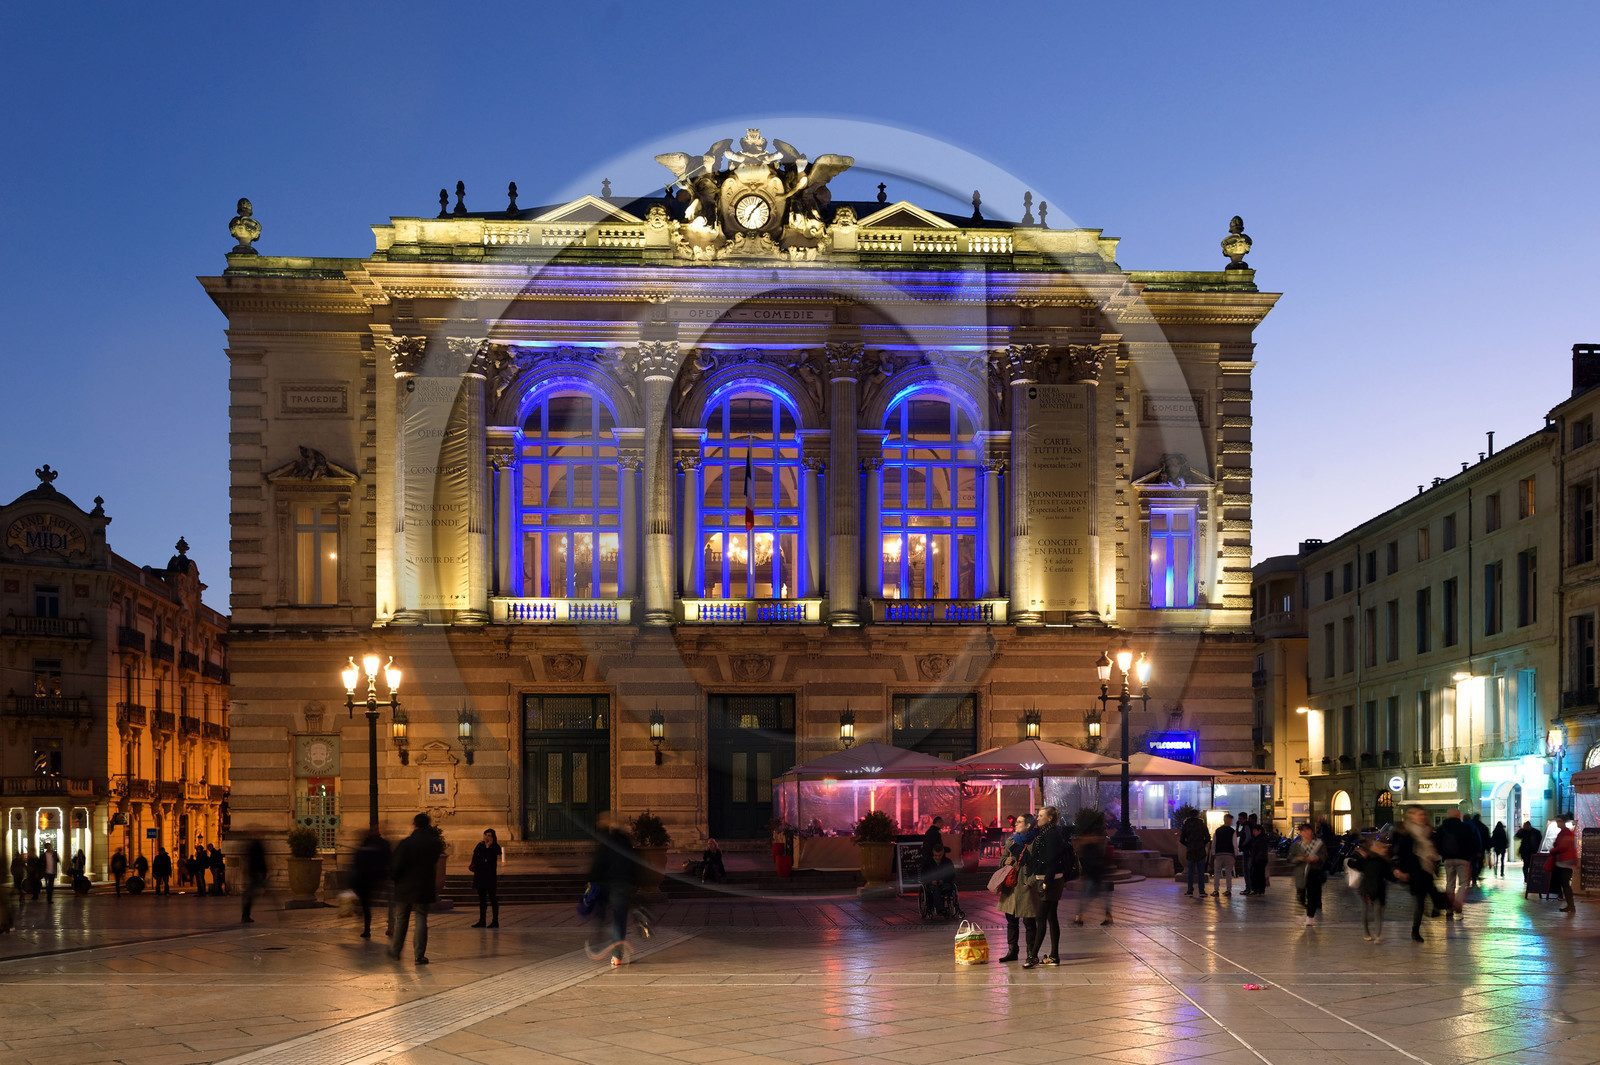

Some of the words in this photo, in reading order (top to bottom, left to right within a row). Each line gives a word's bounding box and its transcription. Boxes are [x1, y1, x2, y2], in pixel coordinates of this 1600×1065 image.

[689, 309, 732, 319] OPERA
[753, 310, 815, 319] COMEDIE
[290, 395, 338, 403] TRAGEDIE
[1152, 404, 1194, 412] COMEDIE
[1043, 438, 1072, 446] CARTE
[1063, 446, 1083, 454] PASS
[1037, 461, 1066, 470] spectacles
[410, 466, 462, 474] CONCERTS
[1028, 490, 1089, 498] ABONNEMENT
[411, 503, 436, 511] POUR
[437, 503, 463, 512] TOUT
[1035, 505, 1065, 514] spectacles
[413, 519, 424, 527] LE
[425, 519, 461, 527] MONDE
[8, 514, 45, 539] GRAND
[49, 514, 82, 543] HOTEL
[26, 531, 68, 550] MIDI
[1037, 539, 1080, 547] CONCERT
[1034, 547, 1046, 555] EN
[1048, 547, 1083, 555] FAMILLE
[415, 556, 442, 564] PARTIR
[443, 556, 455, 564] DE
[432, 783, 443, 793] M
